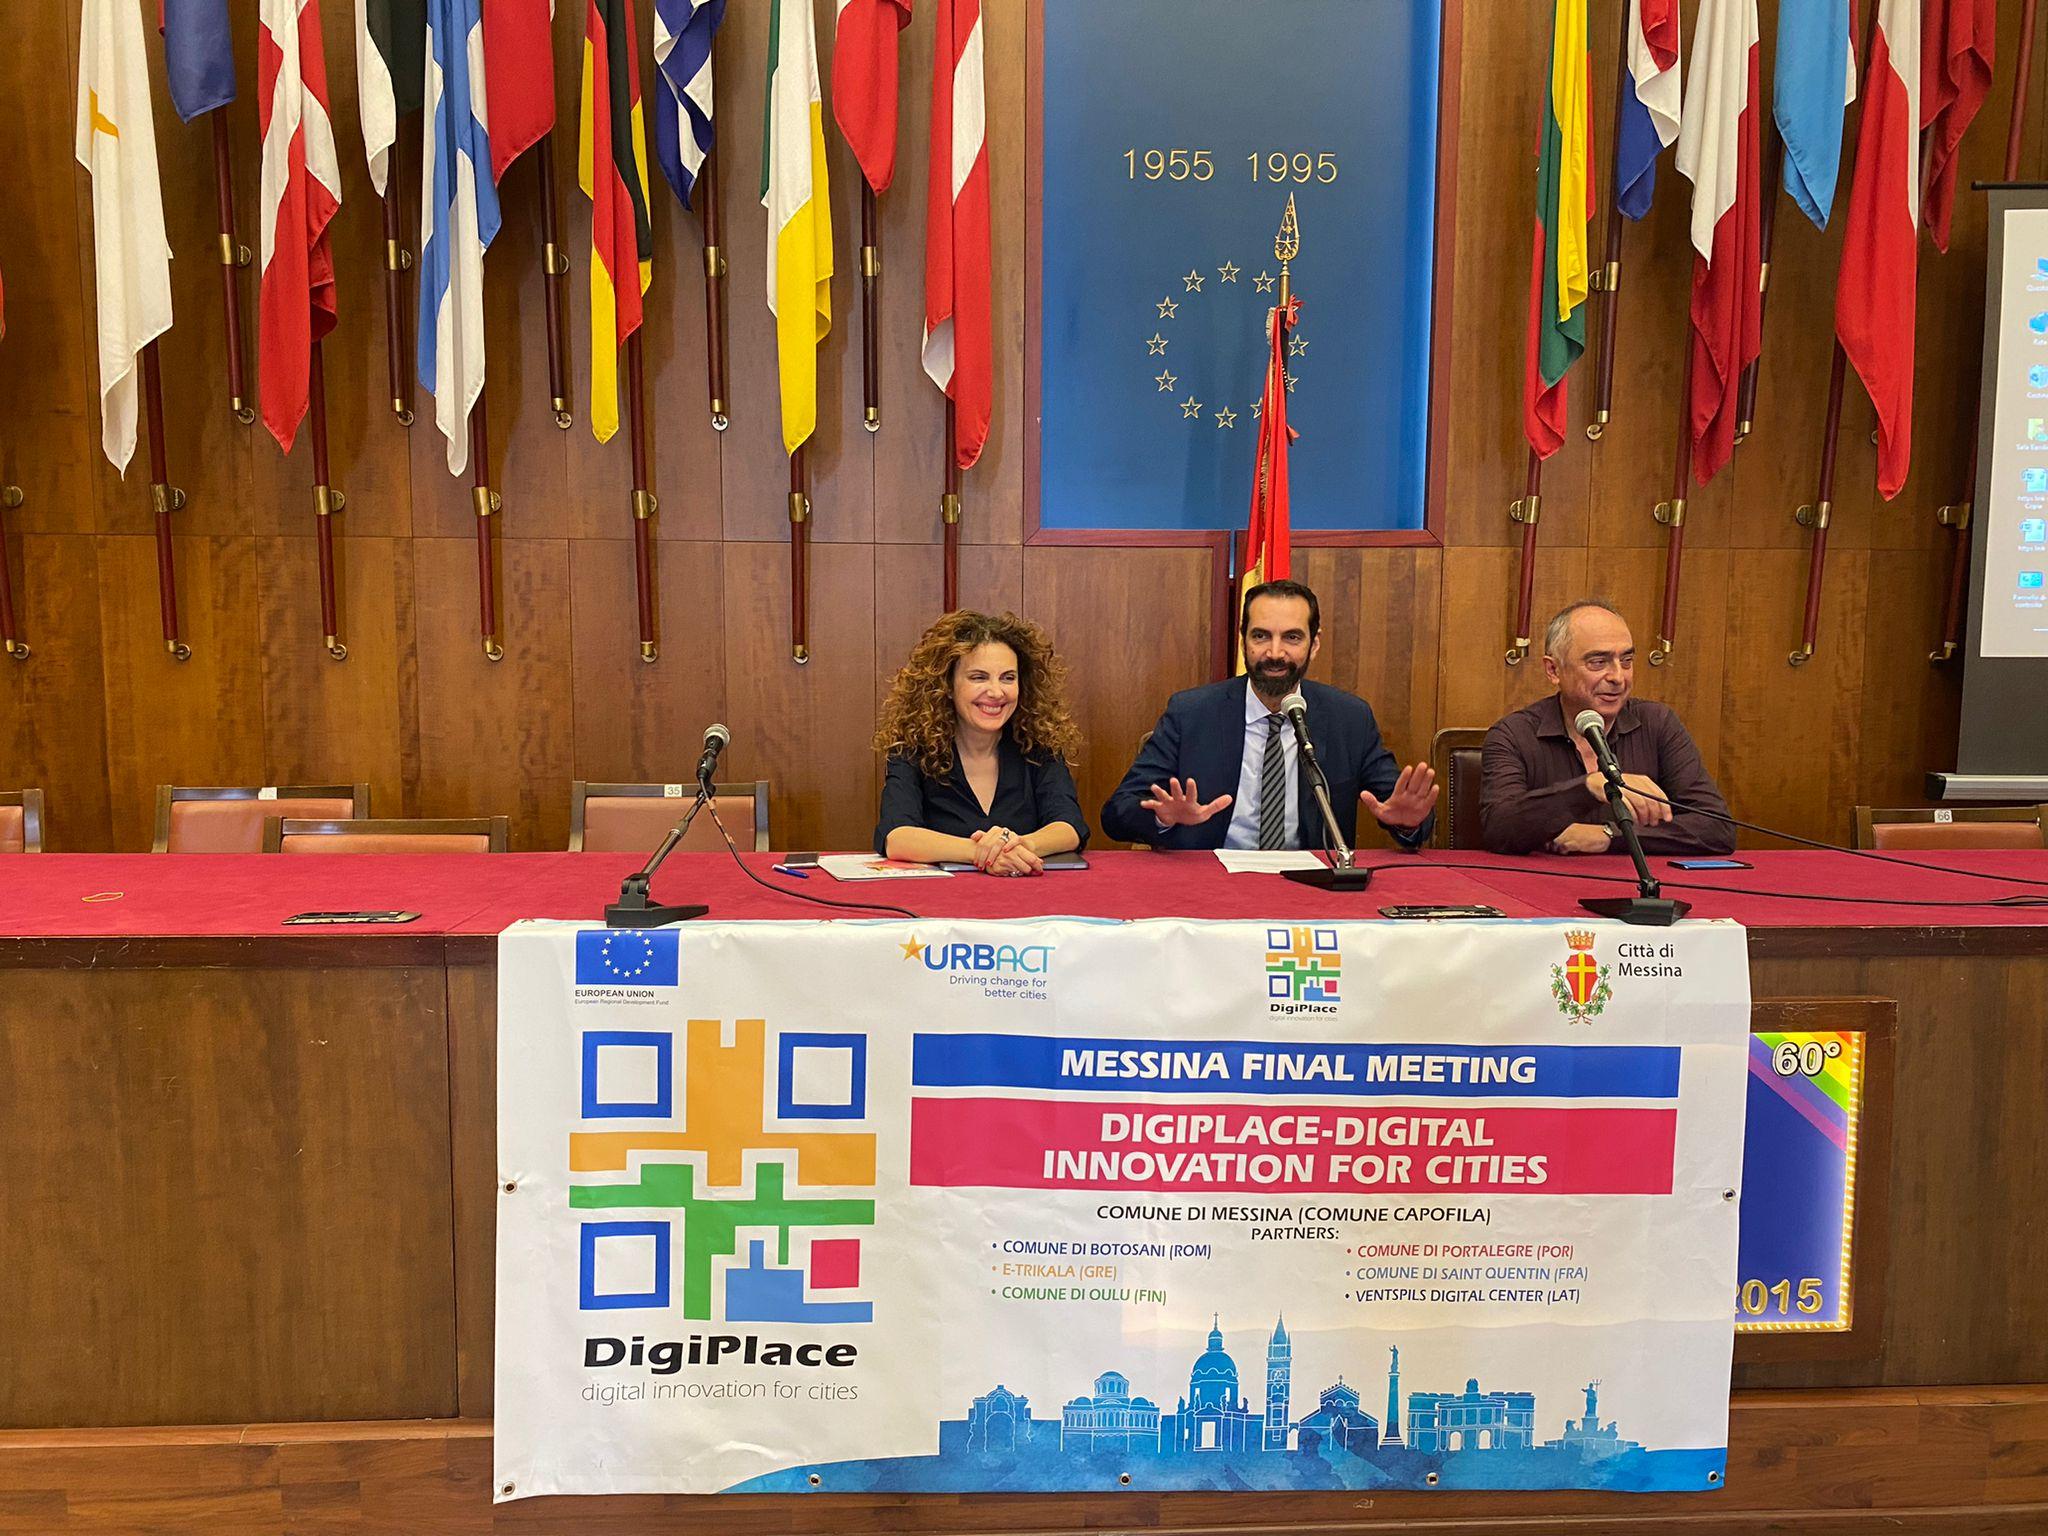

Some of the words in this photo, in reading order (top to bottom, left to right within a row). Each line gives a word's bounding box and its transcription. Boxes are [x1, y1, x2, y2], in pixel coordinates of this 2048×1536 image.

[1123, 149, 1215, 181] 1955
[1247, 152, 1338, 183] 1995
[667, 786, 680, 795] 35
[924, 943, 1056, 973] URBACT
[1618, 943, 1654, 958] Città
[1659, 943, 1674, 958] di
[1618, 963, 1682, 977] Messina
[950, 975, 987, 986] Driving
[990, 976, 1029, 988] change
[1032, 977, 1047, 987] for
[575, 989, 624, 997] EUROPEAN
[626, 990, 655, 998] UNION
[985, 988, 1016, 998] better
[1019, 990, 1047, 1000] cities
[1270, 1004, 1337, 1014] DigiPlace
[1061, 1049, 1230, 1079] MESSINA
[1242, 1052, 1354, 1081] FINAL
[1366, 1055, 1537, 1084] MEETING
[1101, 1113, 1494, 1147] DIGIPLACE-DIGITAL
[1043, 1150, 1315, 1183] INNOVATION
[1328, 1154, 1412, 1184] FOR
[1426, 1154, 1548, 1184] CITIES
[1097, 1205, 1182, 1221] COMUNE
[1188, 1206, 1206, 1220] DI
[1211, 1206, 1293, 1222] MESSINA
[1299, 1207, 1388, 1224] (COMUNE
[1393, 1207, 1491, 1226] CAPOFILA)
[1251, 1227, 1339, 1241] PARTNERS:
[1003, 1240, 1068, 1255] COMUNE
[1071, 1243, 1086, 1255] DI
[1090, 1243, 1165, 1257] BOTOSANI
[1169, 1244, 1212, 1260] (ROM)
[1357, 1244, 1419, 1258] COMUNE
[1423, 1245, 1438, 1257] DI
[1442, 1245, 1533, 1258] PORTALEGRE
[1537, 1245, 1574, 1260] (POR)
[1003, 1263, 1075, 1278] E-TRIKALA
[1079, 1265, 1117, 1280] (GRE)
[1356, 1267, 1419, 1280] COMUNE
[1422, 1267, 1437, 1279] DI
[1441, 1268, 1482, 1280] SAINT
[1485, 1267, 1550, 1281] QUENTIN
[1554, 1267, 1588, 1283] (FRA)
[1002, 1286, 1066, 1301] COMUNE
[1070, 1288, 1085, 1300] DI
[1089, 1288, 1130, 1301] OULU
[1134, 1289, 1167, 1306] (FIN)
[1355, 1289, 1427, 1302] VENTSPILS
[1430, 1290, 1485, 1302] DIGITAL
[1488, 1289, 1543, 1302] CENTER
[1547, 1289, 1580, 1305] (LAT)
[1735, 1277, 1823, 1315] 015
[584, 1334, 858, 1375] DigiPlace
[581, 1382, 646, 1406] digital
[653, 1380, 766, 1399] innovation
[773, 1380, 802, 1399] for
[808, 1382, 858, 1400] cities
